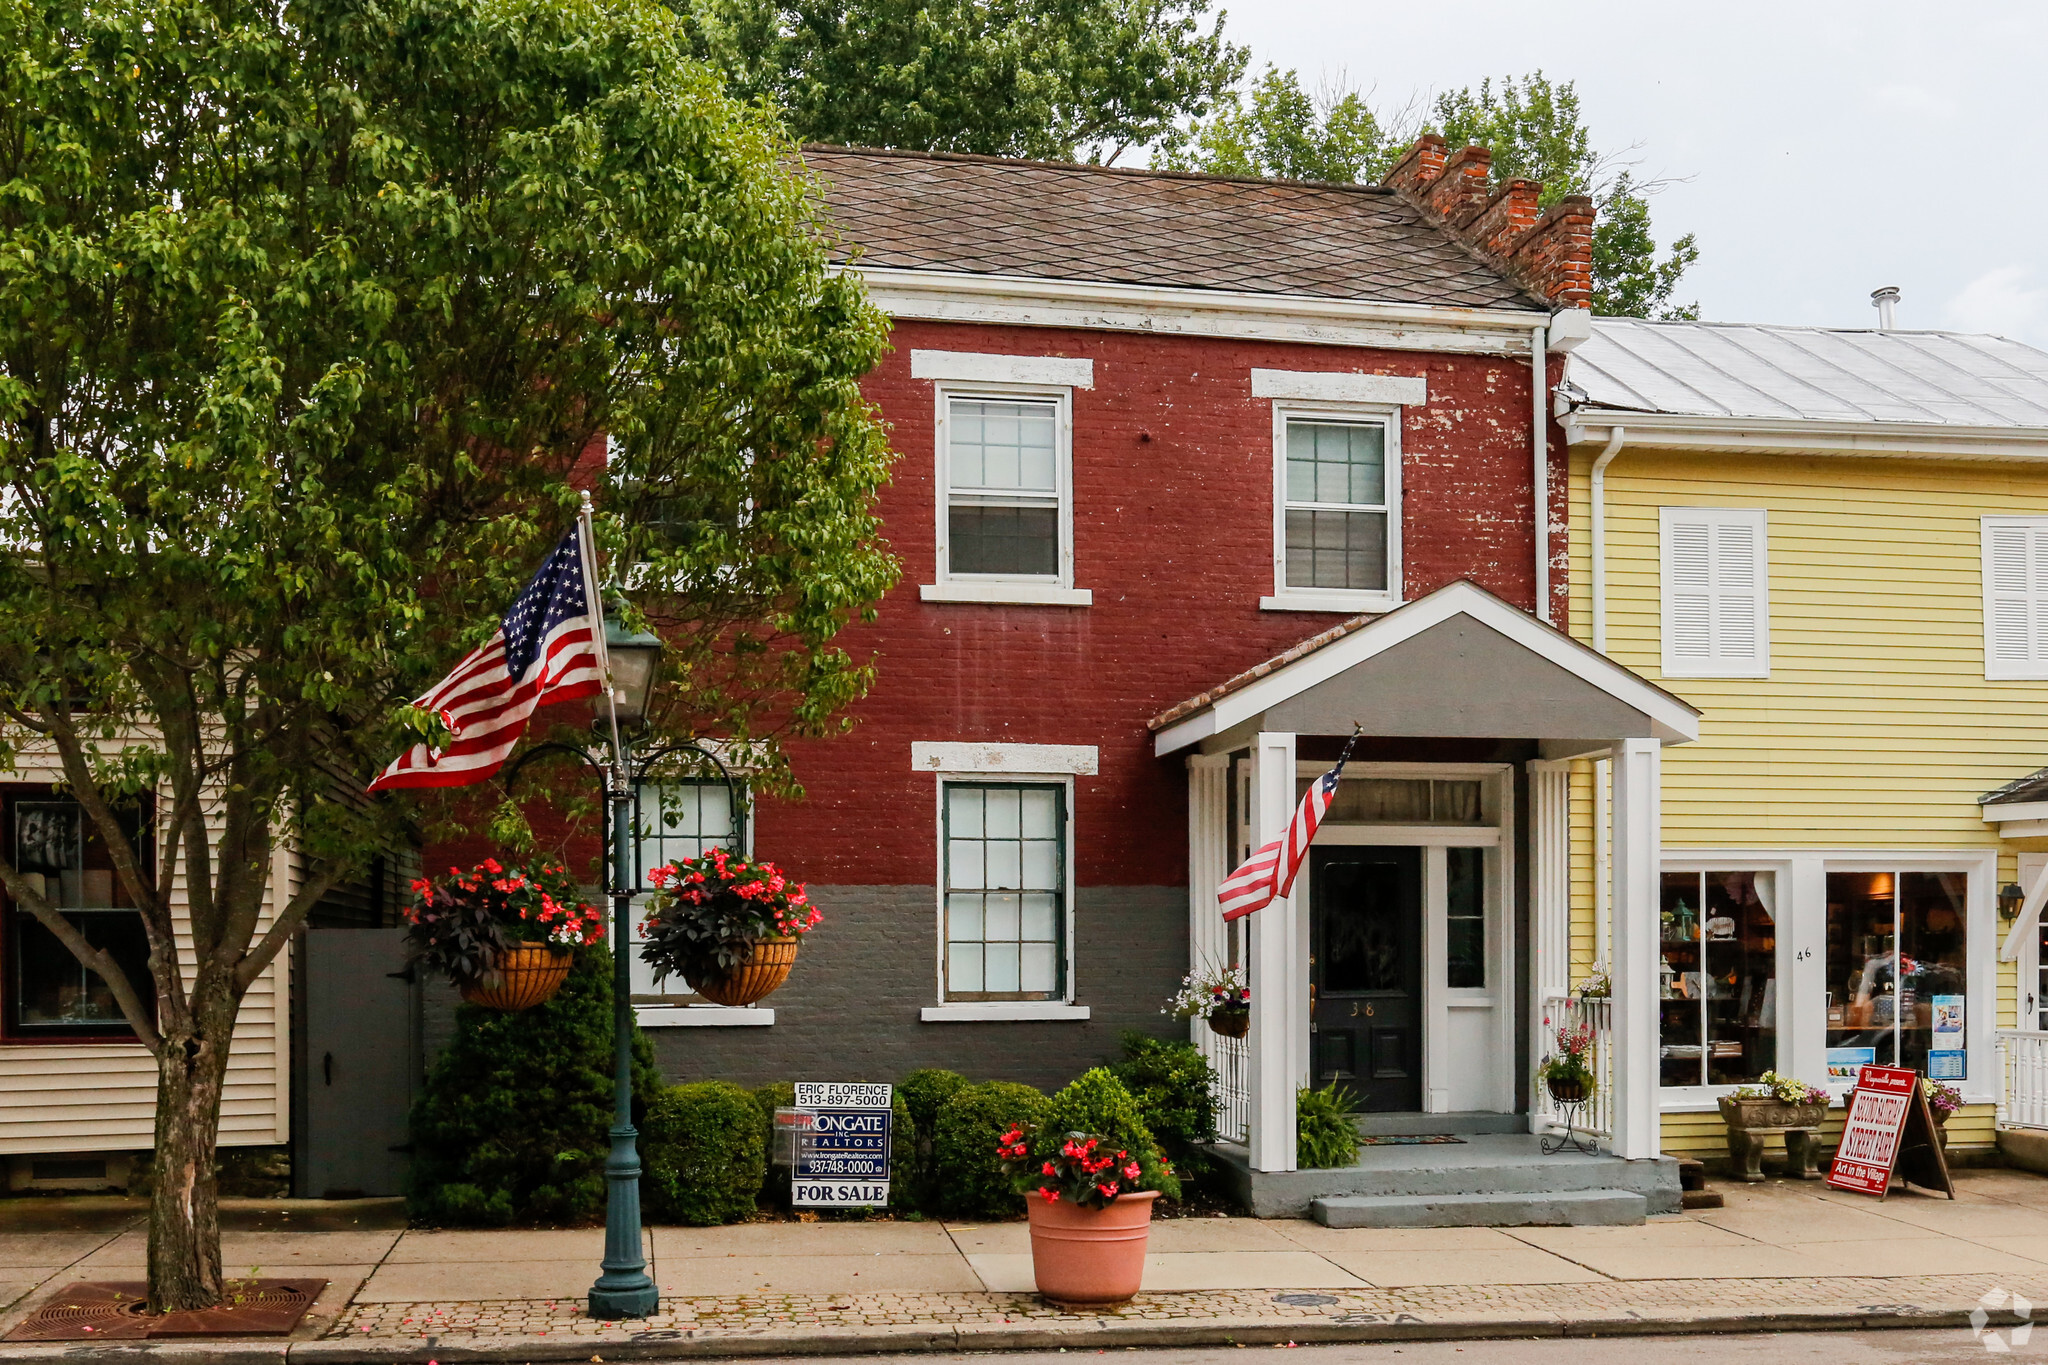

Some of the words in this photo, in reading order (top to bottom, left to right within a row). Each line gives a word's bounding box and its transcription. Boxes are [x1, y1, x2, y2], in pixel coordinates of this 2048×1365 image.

[1797, 947, 1811, 961] 46
[1350, 1002, 1374, 1017] 38
[798, 1084, 824, 1094] ERIC
[829, 1085, 888, 1095] FLORENCE
[800, 1095, 887, 1106] 513-897-5000
[803, 1115, 883, 1131] IRONGATE
[801, 1138, 883, 1147] REALTORS
[1845, 1127, 1877, 1159] STREET
[801, 1152, 882, 1160] www.IrongateRealtors.com
[809, 1160, 874, 1174] 937-748-0000
[1835, 1161, 1848, 1174] Art
[1848, 1164, 1855, 1175] in
[1855, 1166, 1866, 1178] the
[1867, 1167, 1885, 1184] Village
[797, 1185, 834, 1201] FOR
[838, 1185, 884, 1201] SALE
